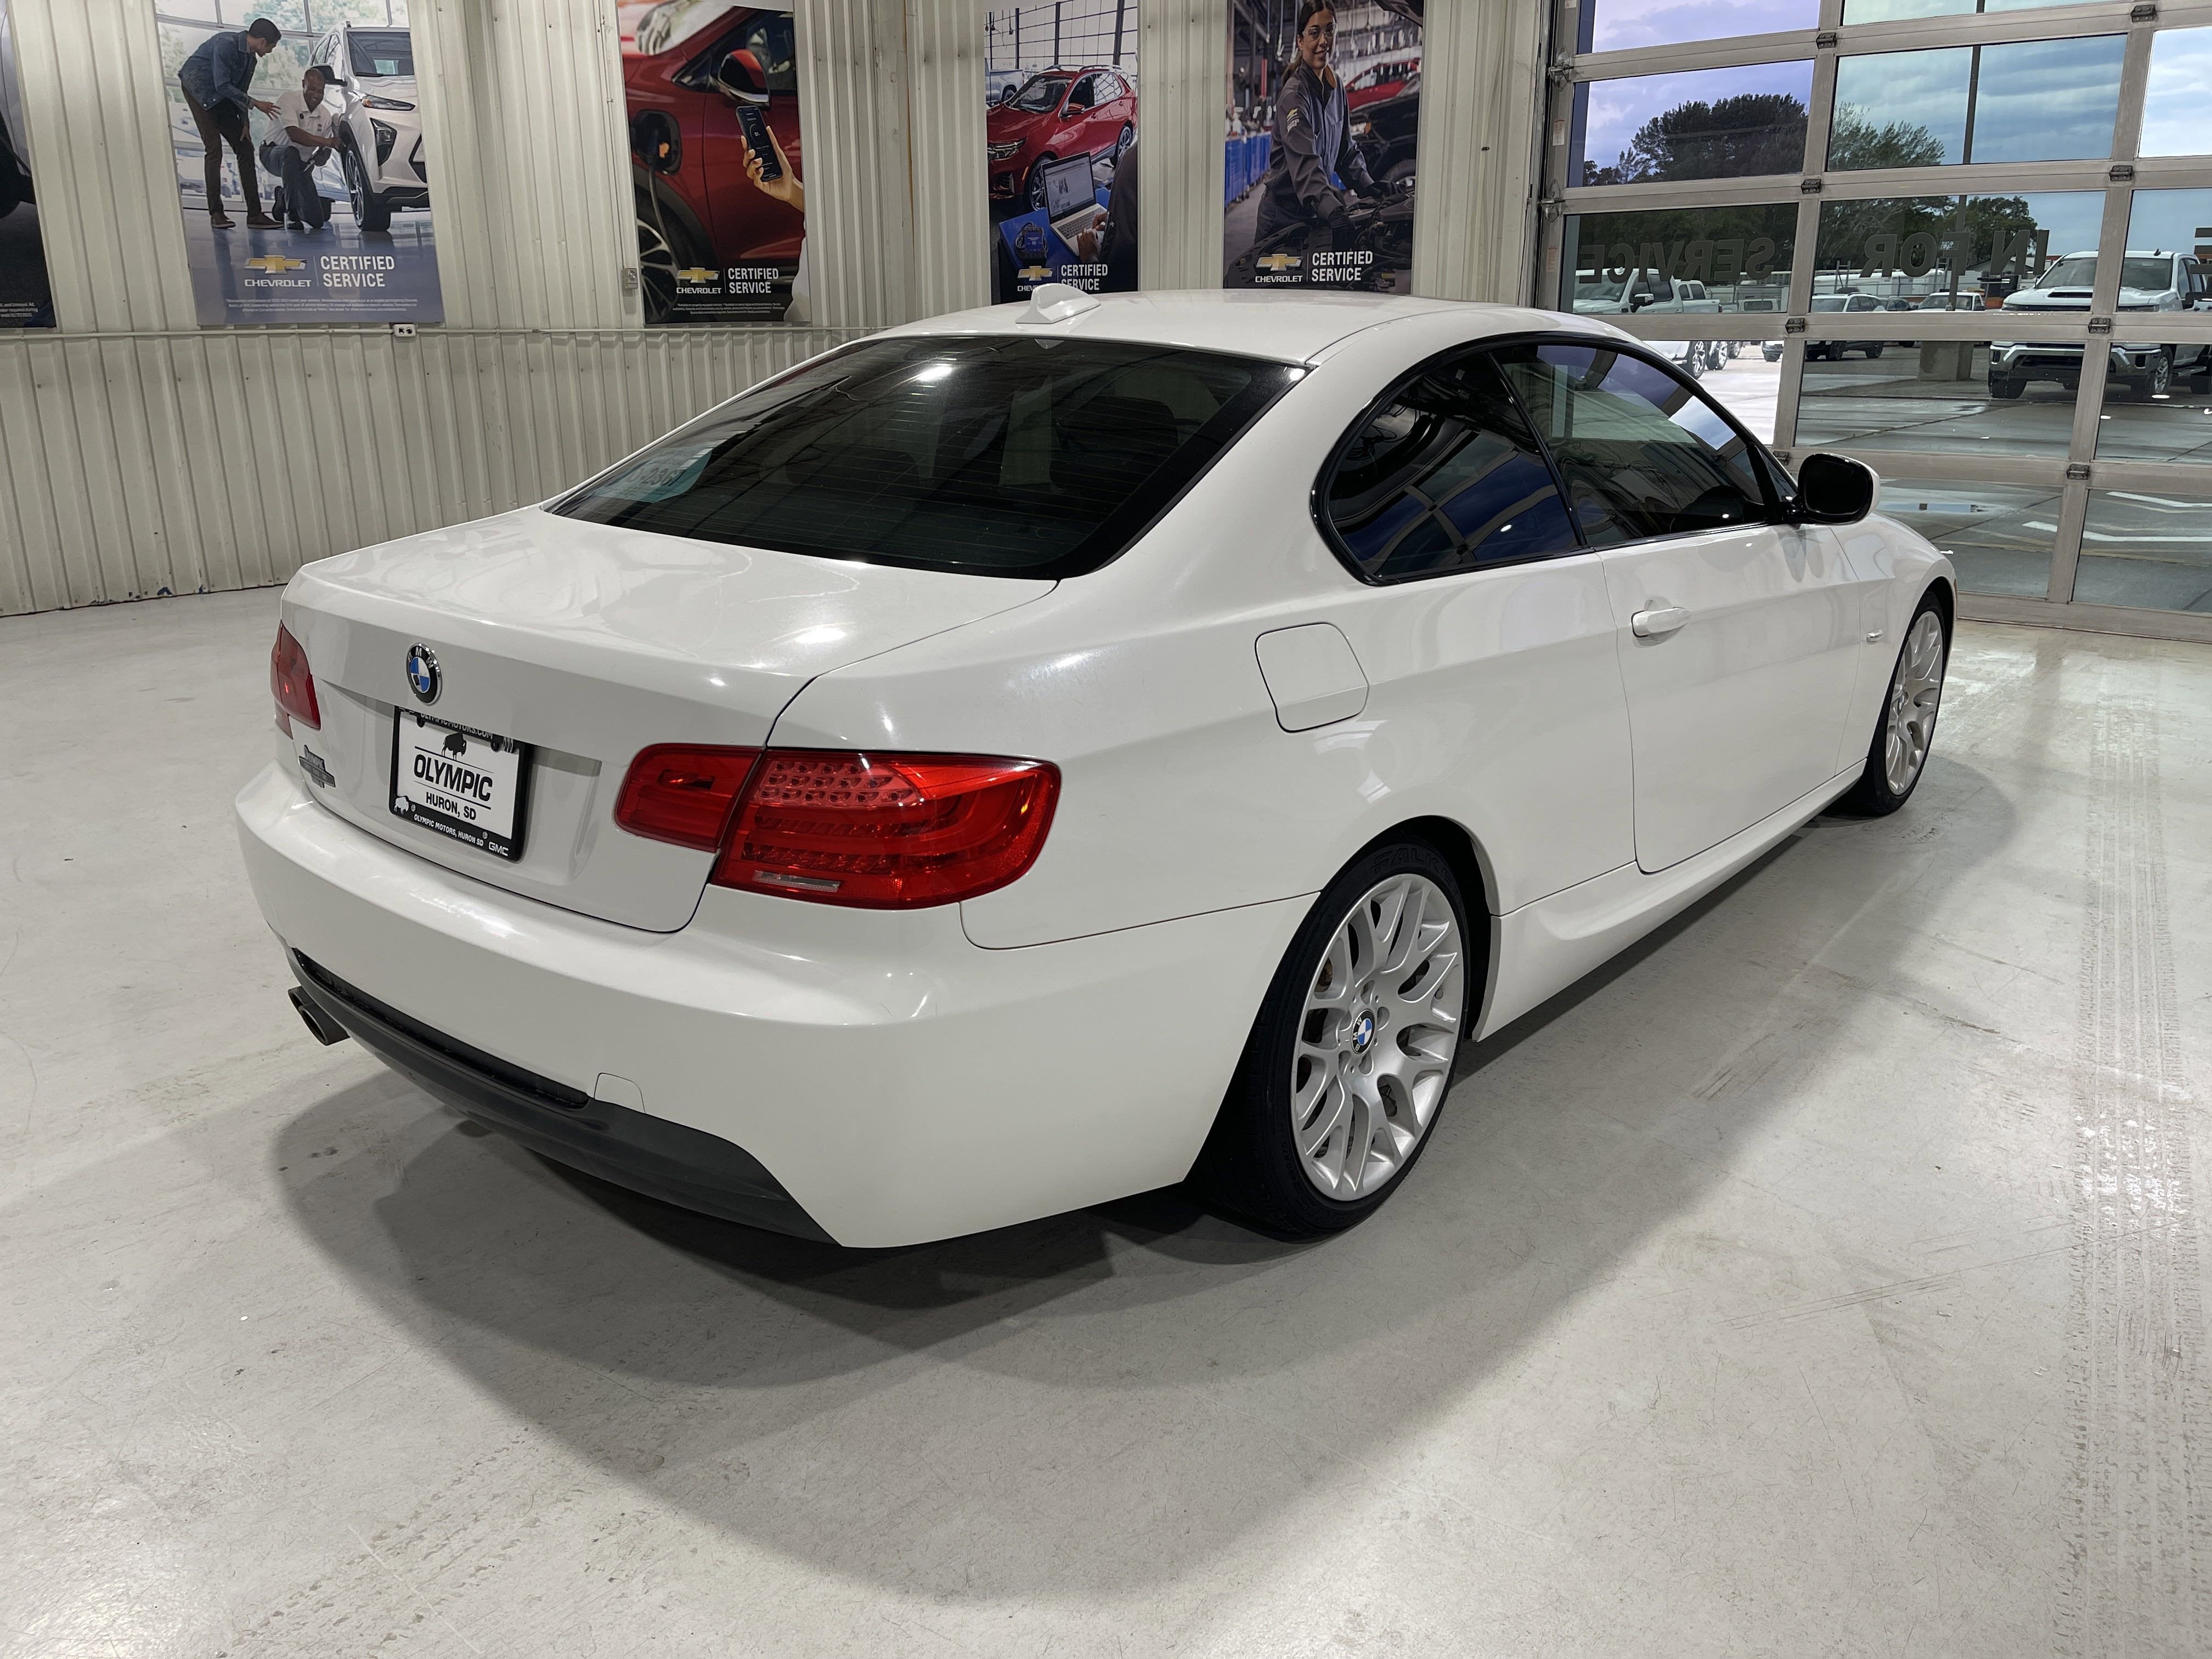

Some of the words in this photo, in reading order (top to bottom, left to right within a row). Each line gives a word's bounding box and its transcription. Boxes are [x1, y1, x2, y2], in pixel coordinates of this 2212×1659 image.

[320, 256, 395, 270] CERTIFIED
[1312, 251, 1373, 266] CERTIFIED
[727, 268, 779, 280] CERTIFIED
[1061, 264, 1108, 276] CERTIFIED
[1311, 267, 1362, 282] SERVICE
[244, 279, 312, 287] CHEVROLET
[323, 273, 386, 288] SERVICE
[1255, 275, 1304, 283] CHEVROLET
[729, 281, 772, 294] SERVICE
[408, 646, 434, 669] BMW
[413, 754, 493, 802] OLYMPIC
[426, 791, 460, 817] HURON,
[463, 805, 476, 820] SD
[414, 814, 434, 827] OLYMPIC
[435, 821, 457, 837] MOTORS,
[458, 831, 476, 844] HURON
[476, 838, 484, 847] SD
[488, 841, 509, 856] GMC
[1352, 1017, 1362, 1052] BMW
